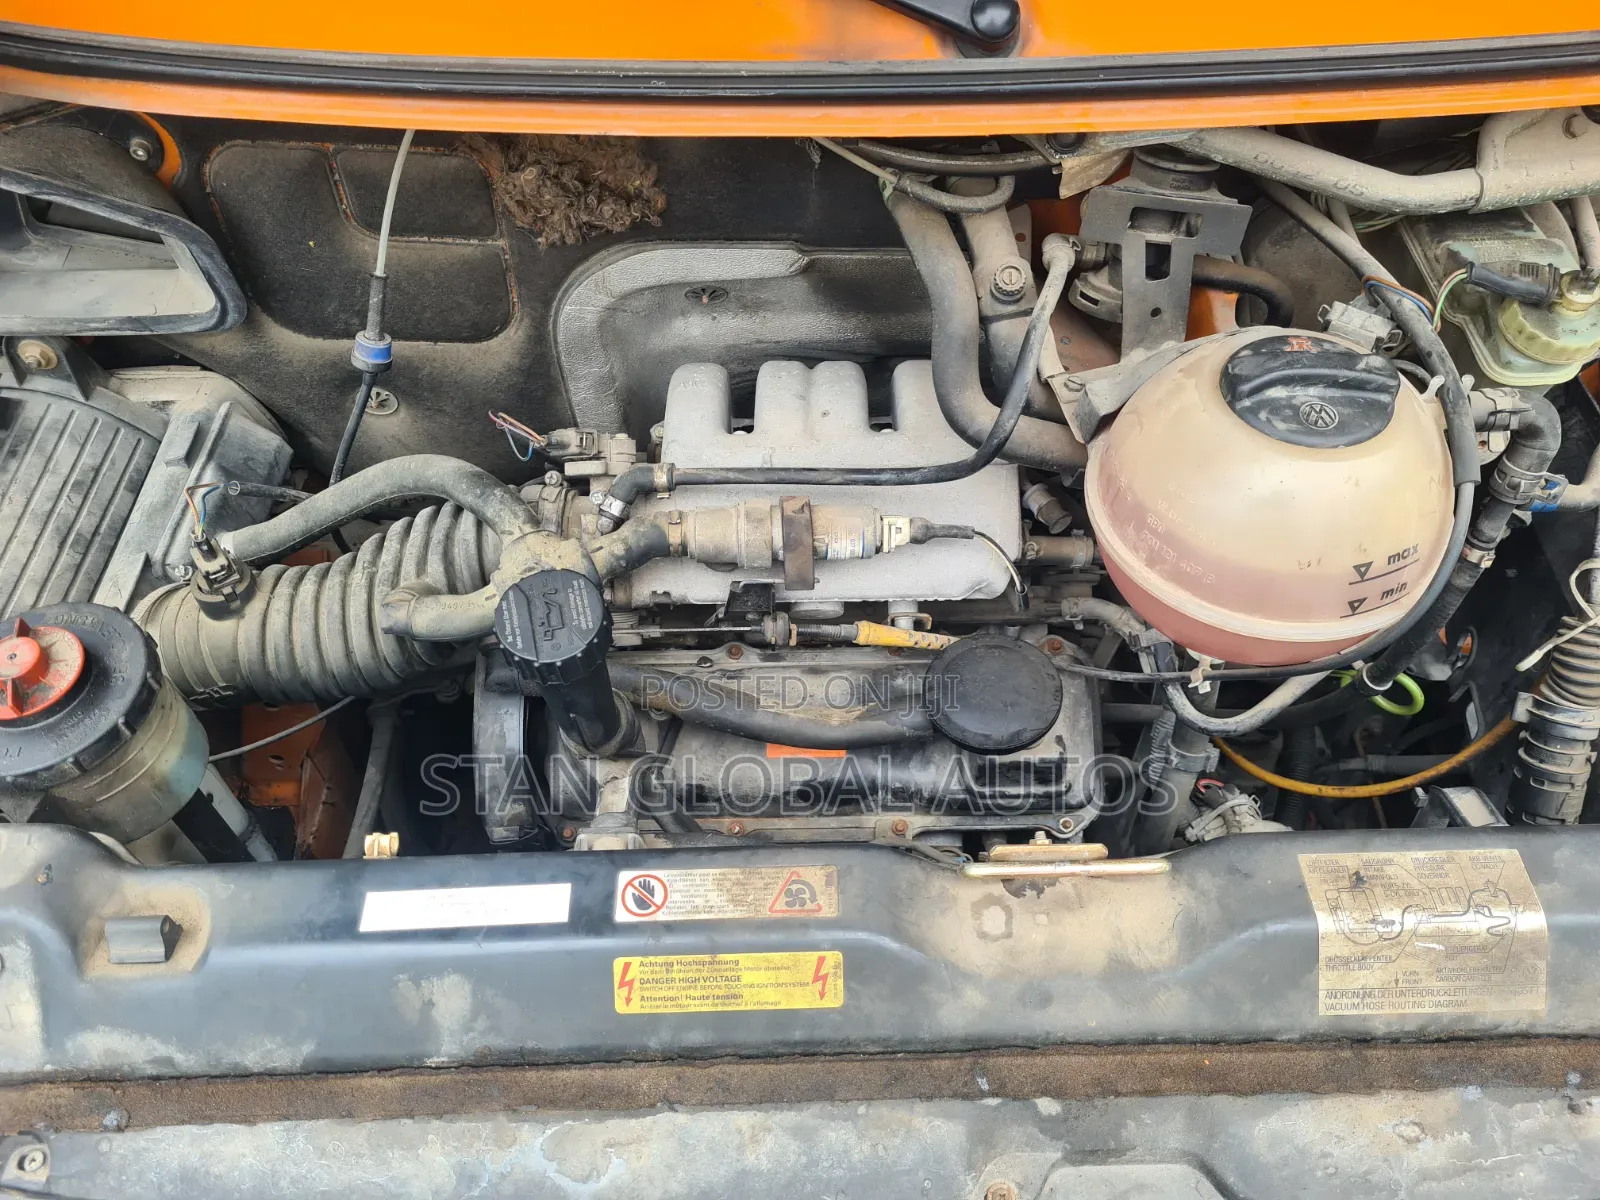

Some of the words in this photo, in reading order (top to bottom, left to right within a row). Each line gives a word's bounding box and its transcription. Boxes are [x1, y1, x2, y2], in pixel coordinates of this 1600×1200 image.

[1387, 543, 1419, 566] max
[1380, 581, 1407, 601] min
[639, 960, 674, 969] Achtung
[676, 958, 740, 968] Hochspannung
[639, 977, 677, 985] DANGER
[678, 976, 700, 985] HIGH
[702, 975, 742, 984] VOLTAGE
[639, 994, 683, 1003] Attention!
[712, 992, 744, 1000] tension
[1325, 990, 1376, 1000] ANORDNUNG
[1377, 989, 1393, 999] DER
[1324, 1002, 1361, 1011] VACUUM
[1362, 1001, 1387, 1010] HOSE
[1388, 1000, 1425, 1009] ROUTING
[1428, 999, 1468, 1009] DIAGRAM
